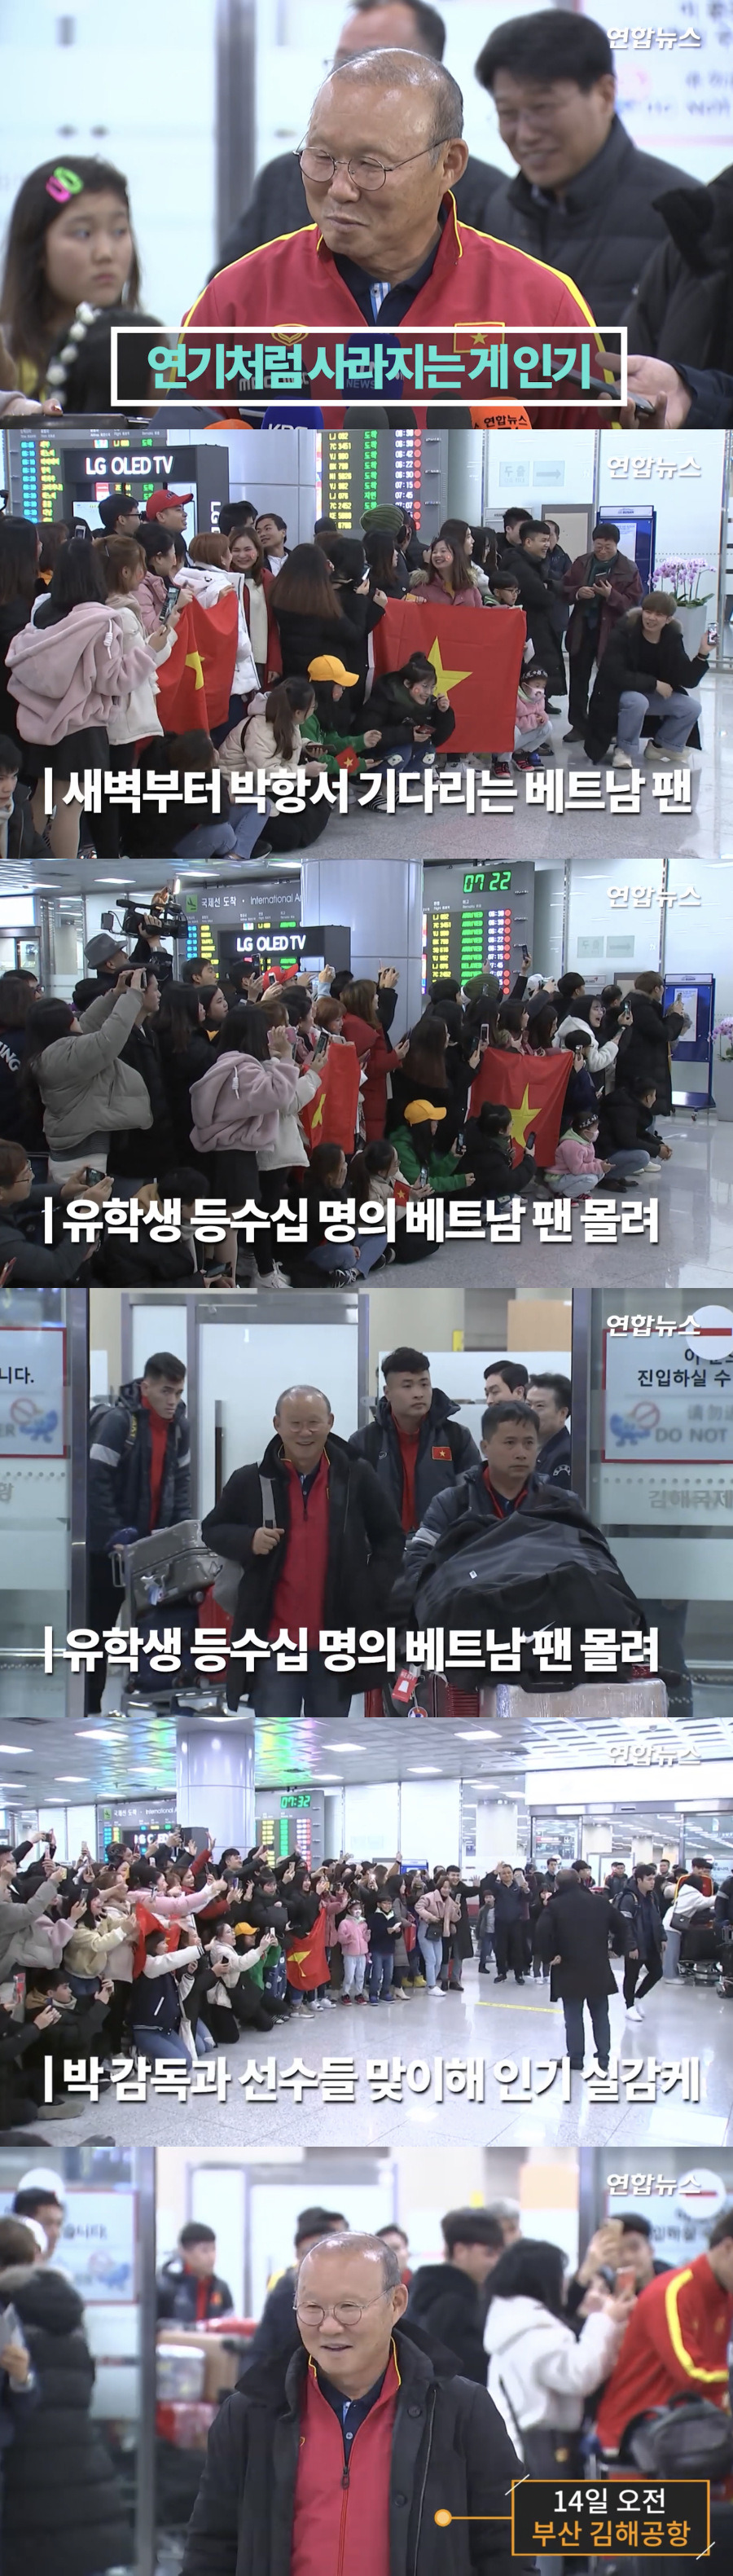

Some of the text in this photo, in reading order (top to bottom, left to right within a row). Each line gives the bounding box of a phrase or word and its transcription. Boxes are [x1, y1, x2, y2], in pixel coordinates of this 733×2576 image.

[484, 415, 528, 428] 연합뉴스
[364, 430, 377, 438] 도착
[364, 441, 377, 450] 도착
[364, 451, 377, 459] 도착
[86, 455, 173, 475] LG OLED TV
[364, 461, 377, 469] 도착
[364, 472, 377, 481] 도착
[364, 482, 377, 490] 도착
[395, 481, 414, 489] 07:15
[364, 492, 377, 500] 지연
[201, 896, 221, 908] 국제선
[223, 895, 236, 907] 도착
[250, 894, 293, 905] International
[236, 935, 306, 952] LG OLED TV
[638, 1369, 731, 1387] 진입하실 수
[656, 1427, 727, 1443] DO NOT
[280, 1795, 311, 1809] 07:32
